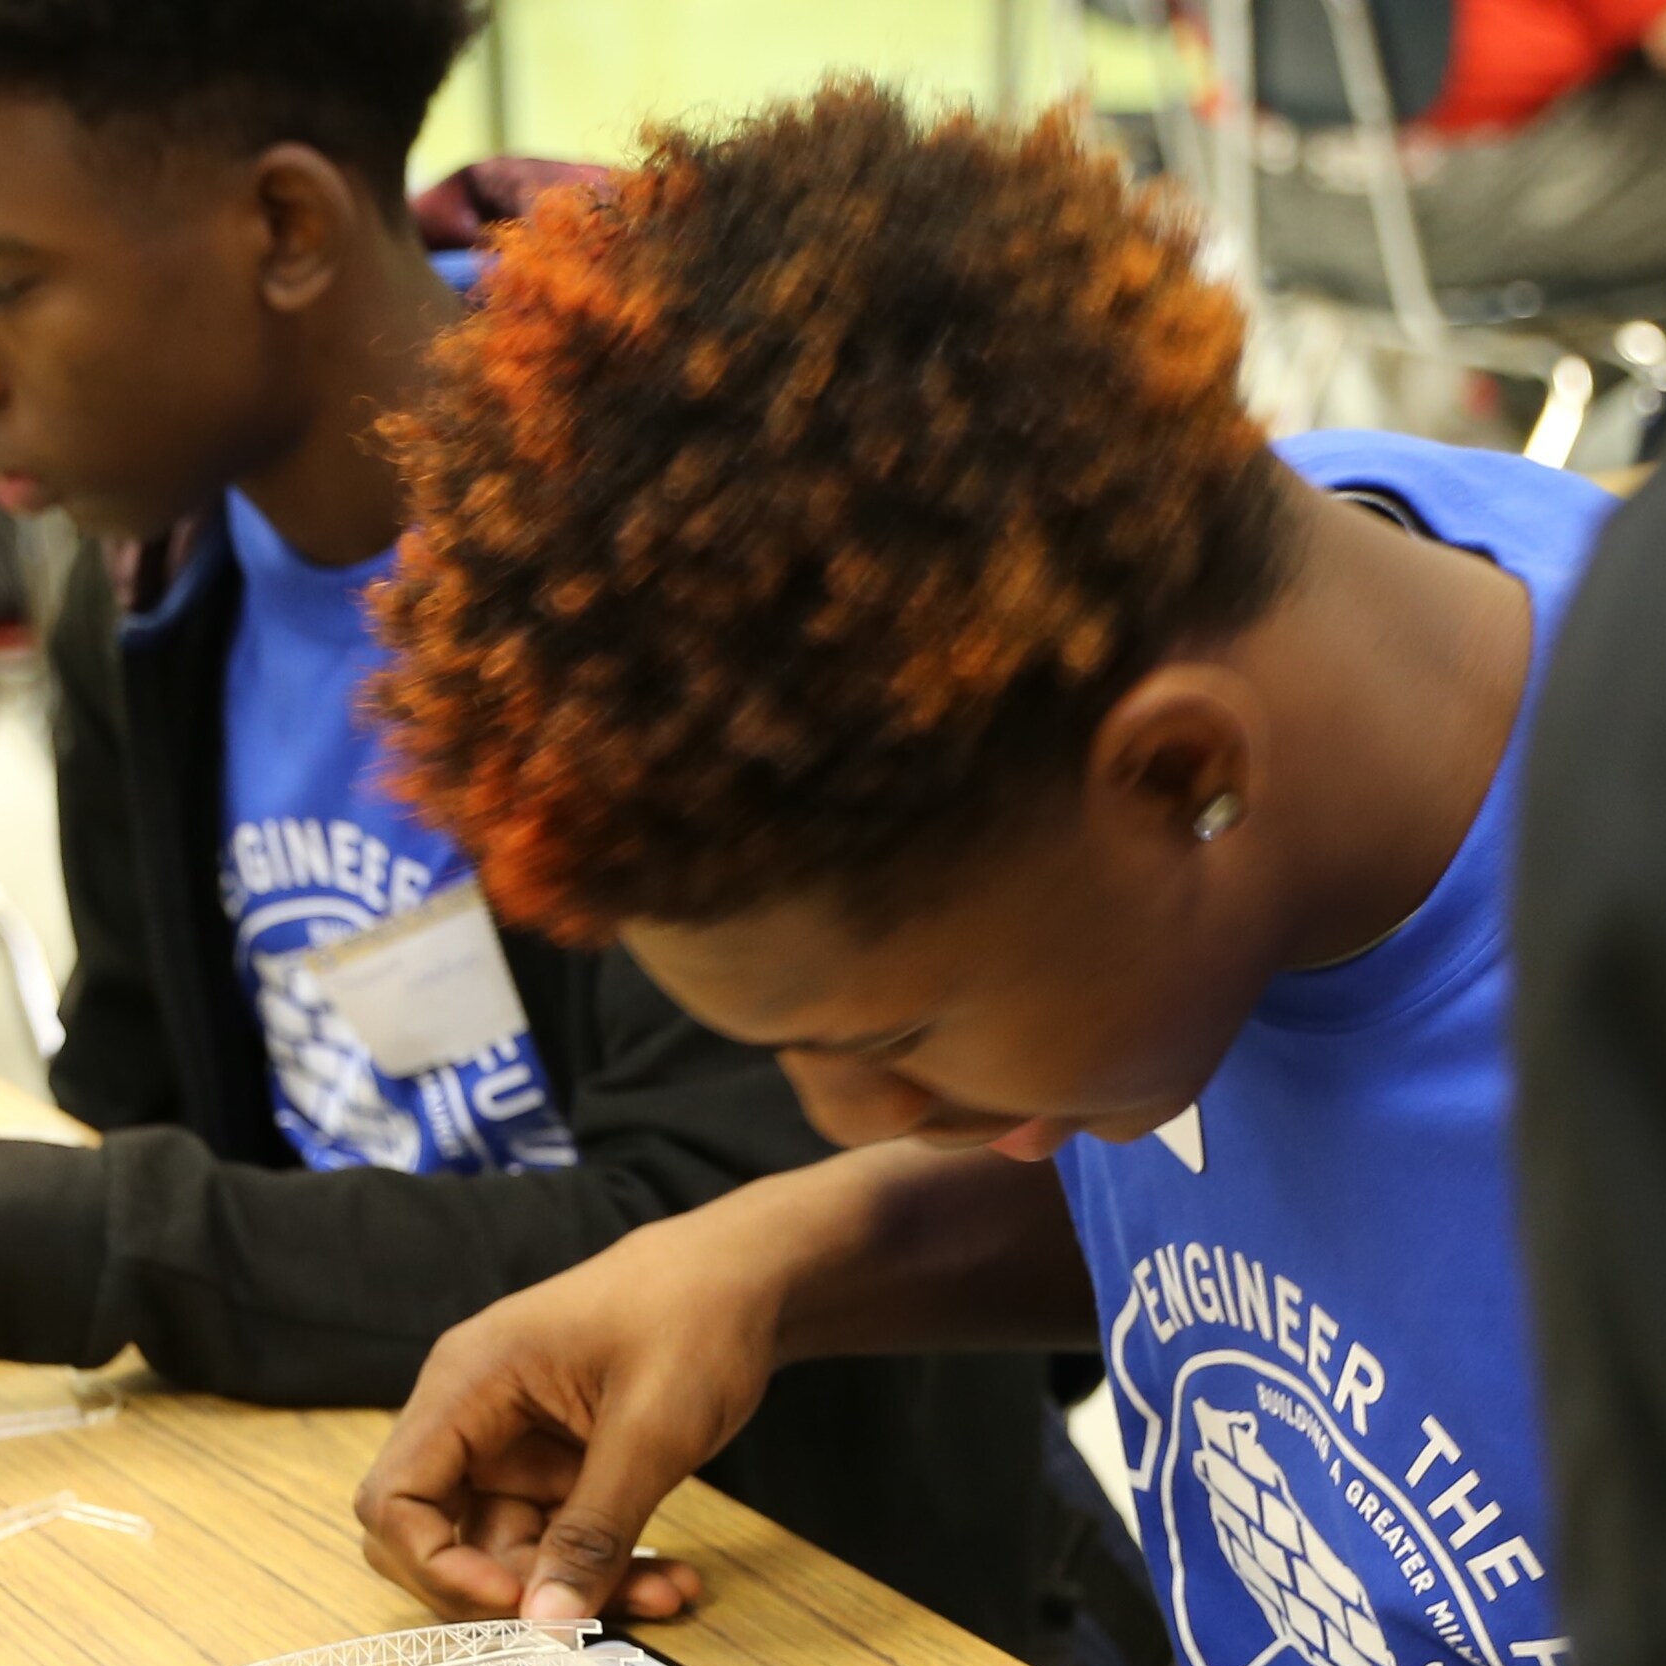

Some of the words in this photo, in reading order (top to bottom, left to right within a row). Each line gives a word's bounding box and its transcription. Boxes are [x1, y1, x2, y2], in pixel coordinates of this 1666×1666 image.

[1132, 1241, 1386, 1436] ENGINEER
[1404, 1414, 1545, 1602] THE
[1344, 1478, 1437, 1597] GREATER
